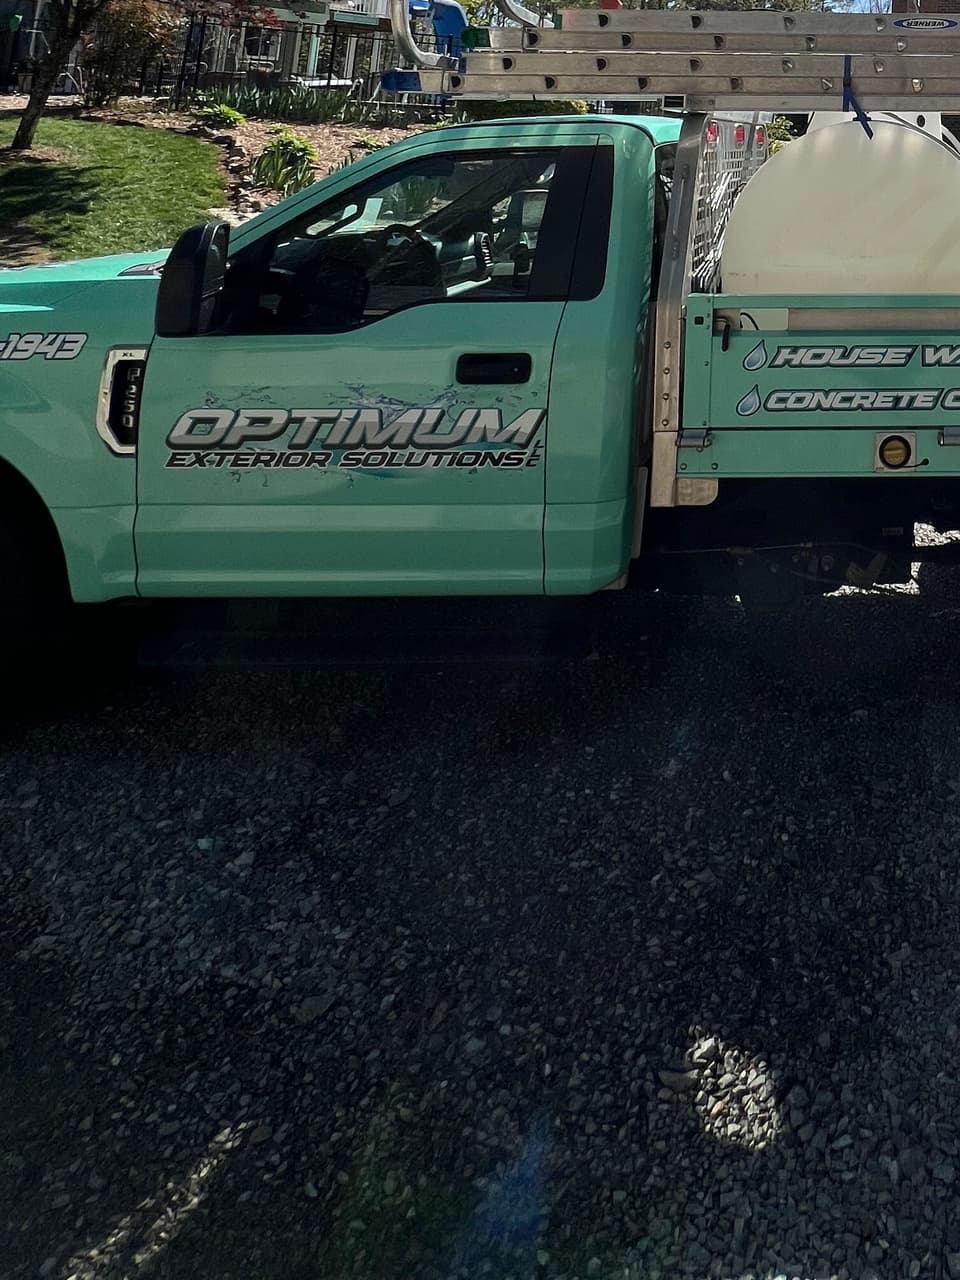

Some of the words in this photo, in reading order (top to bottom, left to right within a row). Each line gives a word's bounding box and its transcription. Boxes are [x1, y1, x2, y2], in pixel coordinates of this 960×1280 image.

[771, 346, 916, 366] HOUSE
[765, 390, 940, 410] CONCRETE
[167, 408, 547, 450] OPTIMUM
[165, 452, 332, 468] EXTERIOR
[339, 451, 527, 468] SOLUTIONS
[525, 439, 544, 468] LLC
